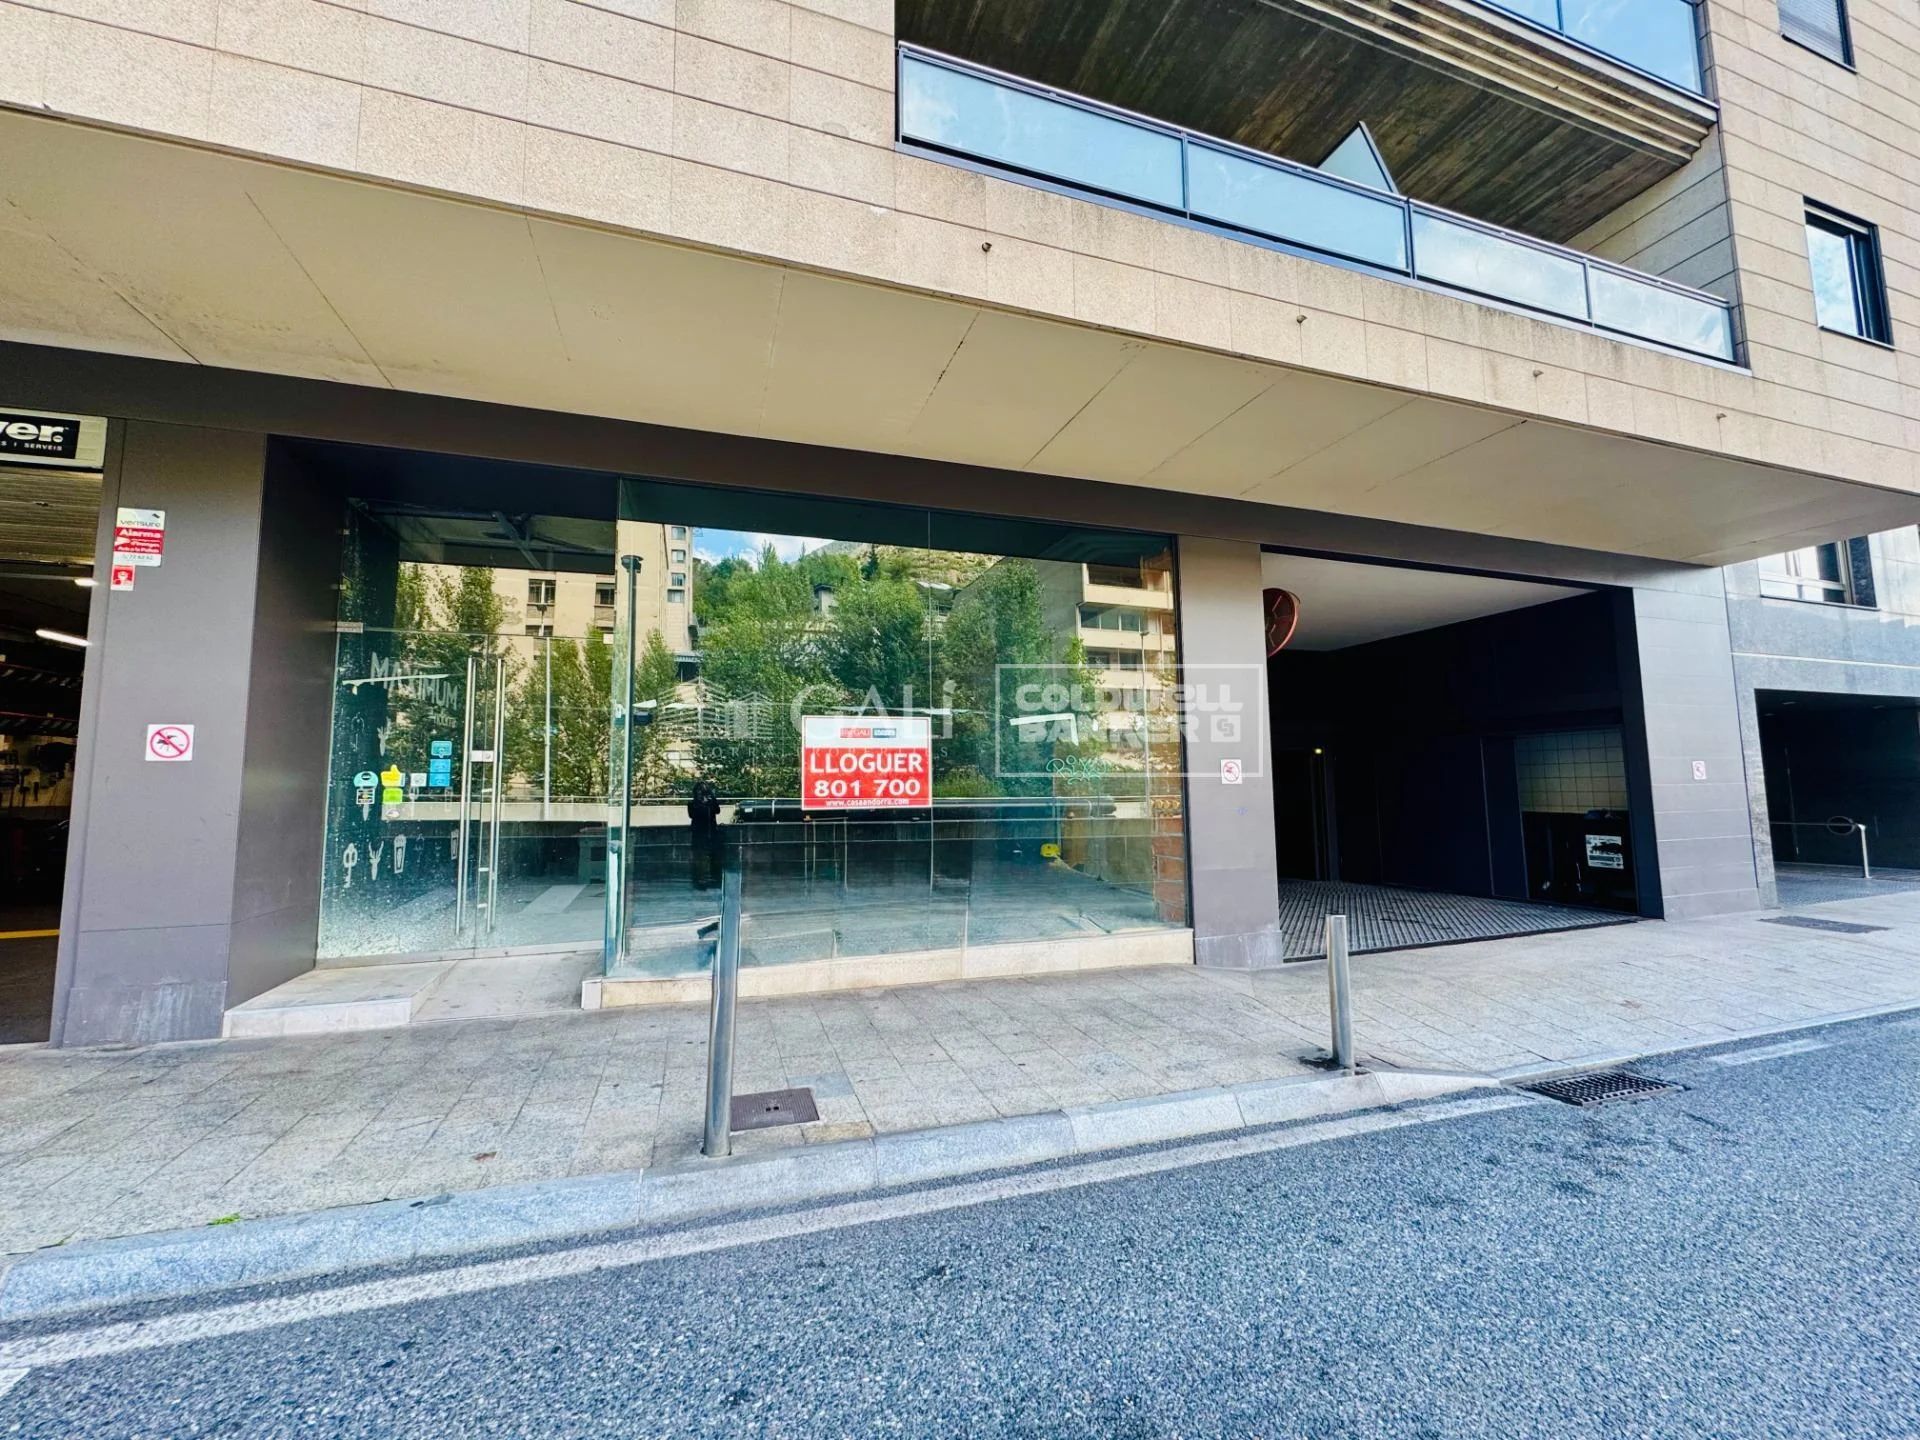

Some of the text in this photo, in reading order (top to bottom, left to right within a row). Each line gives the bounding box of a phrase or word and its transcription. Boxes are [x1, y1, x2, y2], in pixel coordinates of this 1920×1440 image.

[24, 443, 63, 451] SERVEIS
[119, 528, 162, 539] Alarma
[370, 651, 459, 711] MAXIMUM
[810, 752, 924, 774] LLOGUER
[813, 778, 921, 798] 801 700
